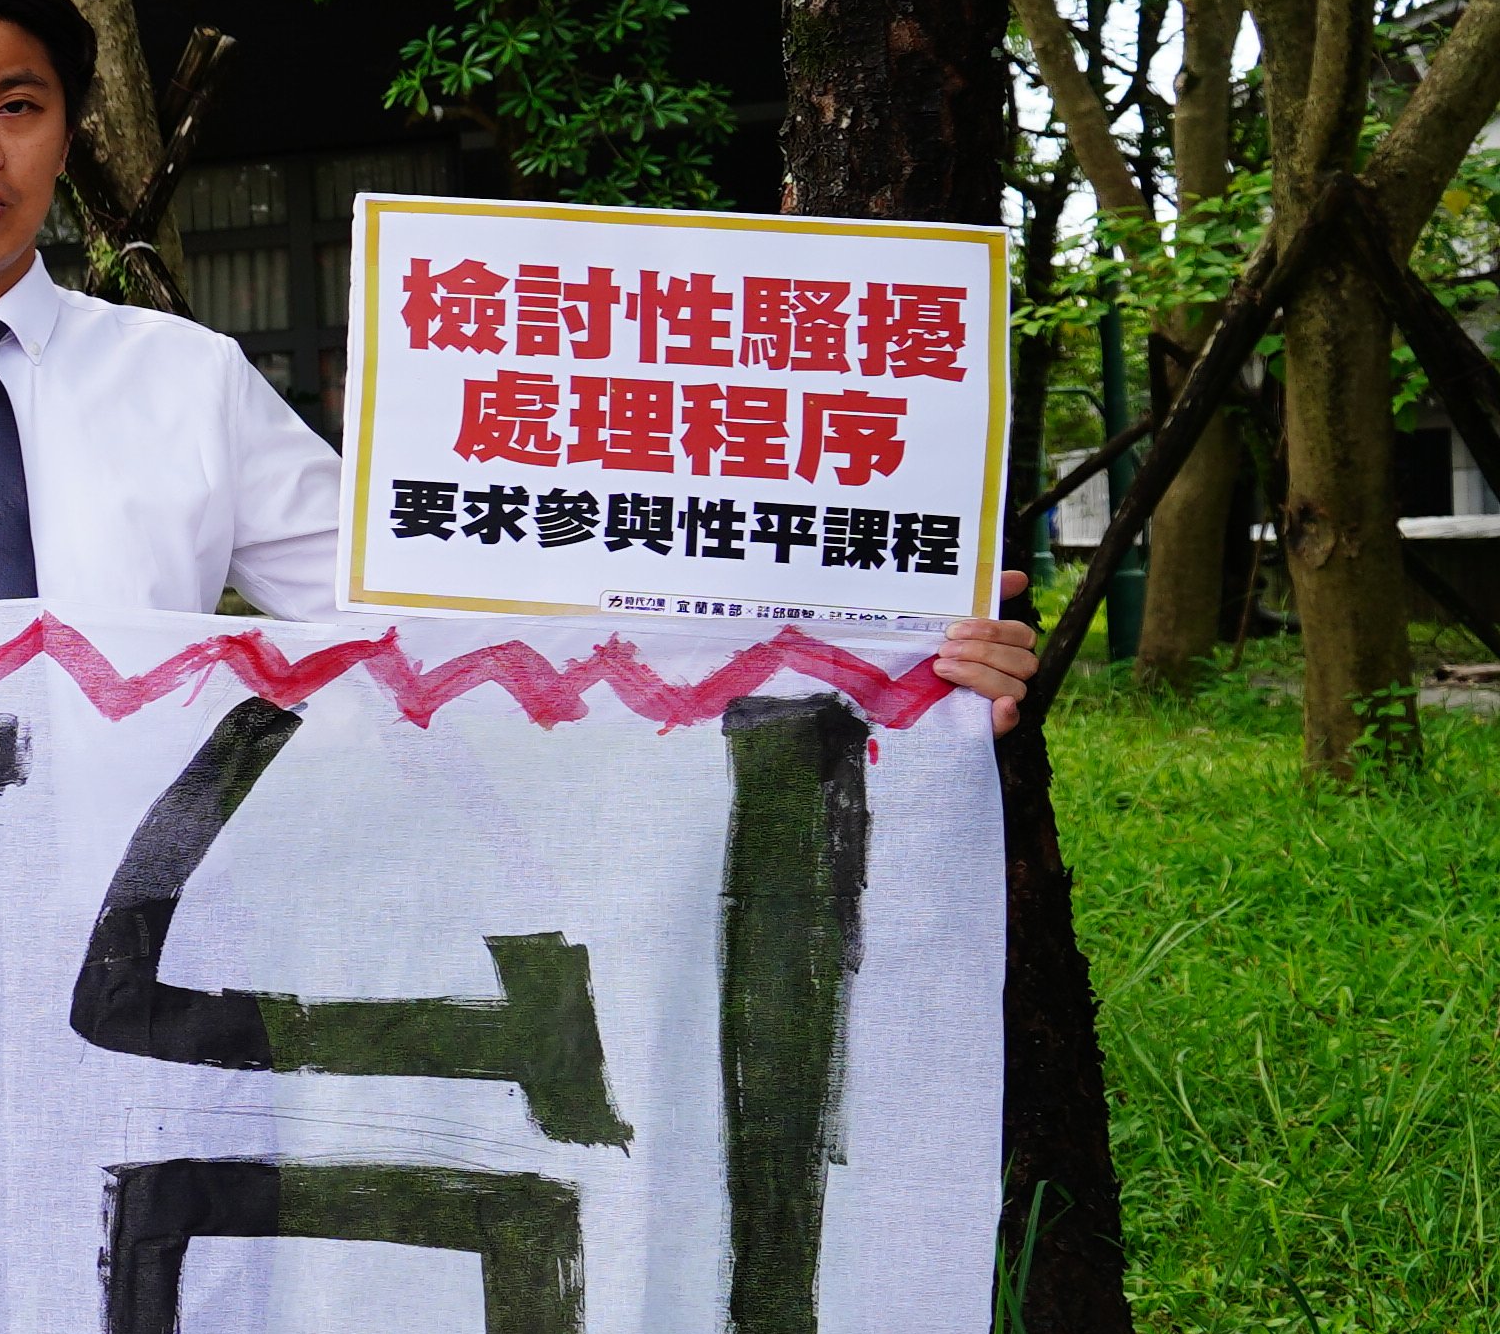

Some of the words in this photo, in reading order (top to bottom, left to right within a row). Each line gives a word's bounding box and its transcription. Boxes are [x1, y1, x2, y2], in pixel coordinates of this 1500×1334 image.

[401, 257, 969, 383] 檢討性騷擾
[453, 369, 908, 487] 處理程序
[389, 479, 961, 576] 要求參與性平課程
[676, 600, 742, 617] 宜蘭黨部
